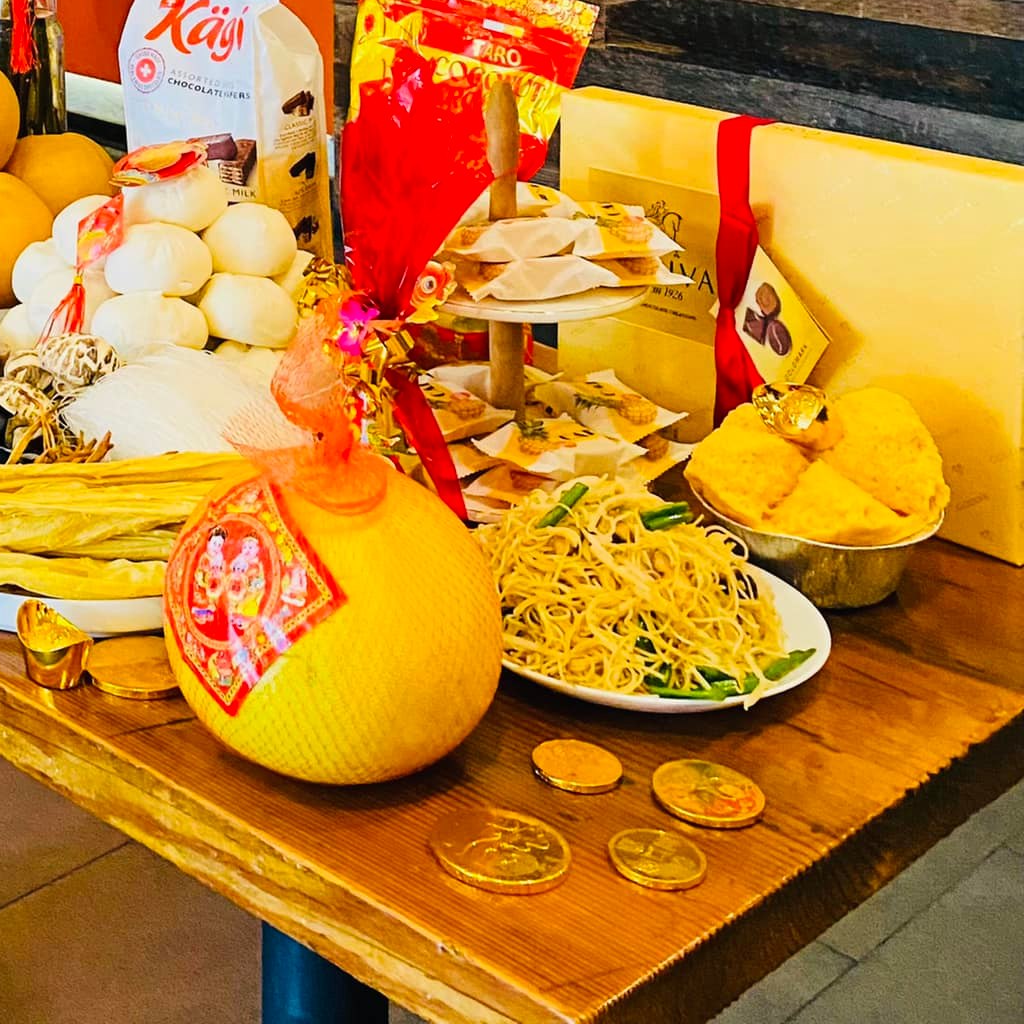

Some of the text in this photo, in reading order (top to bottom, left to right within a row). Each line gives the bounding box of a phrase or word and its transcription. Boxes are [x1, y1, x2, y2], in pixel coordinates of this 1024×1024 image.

[472, 38, 522, 67] TARO
[232, 188, 256, 198] MILK
[664, 287, 683, 301] 1926
